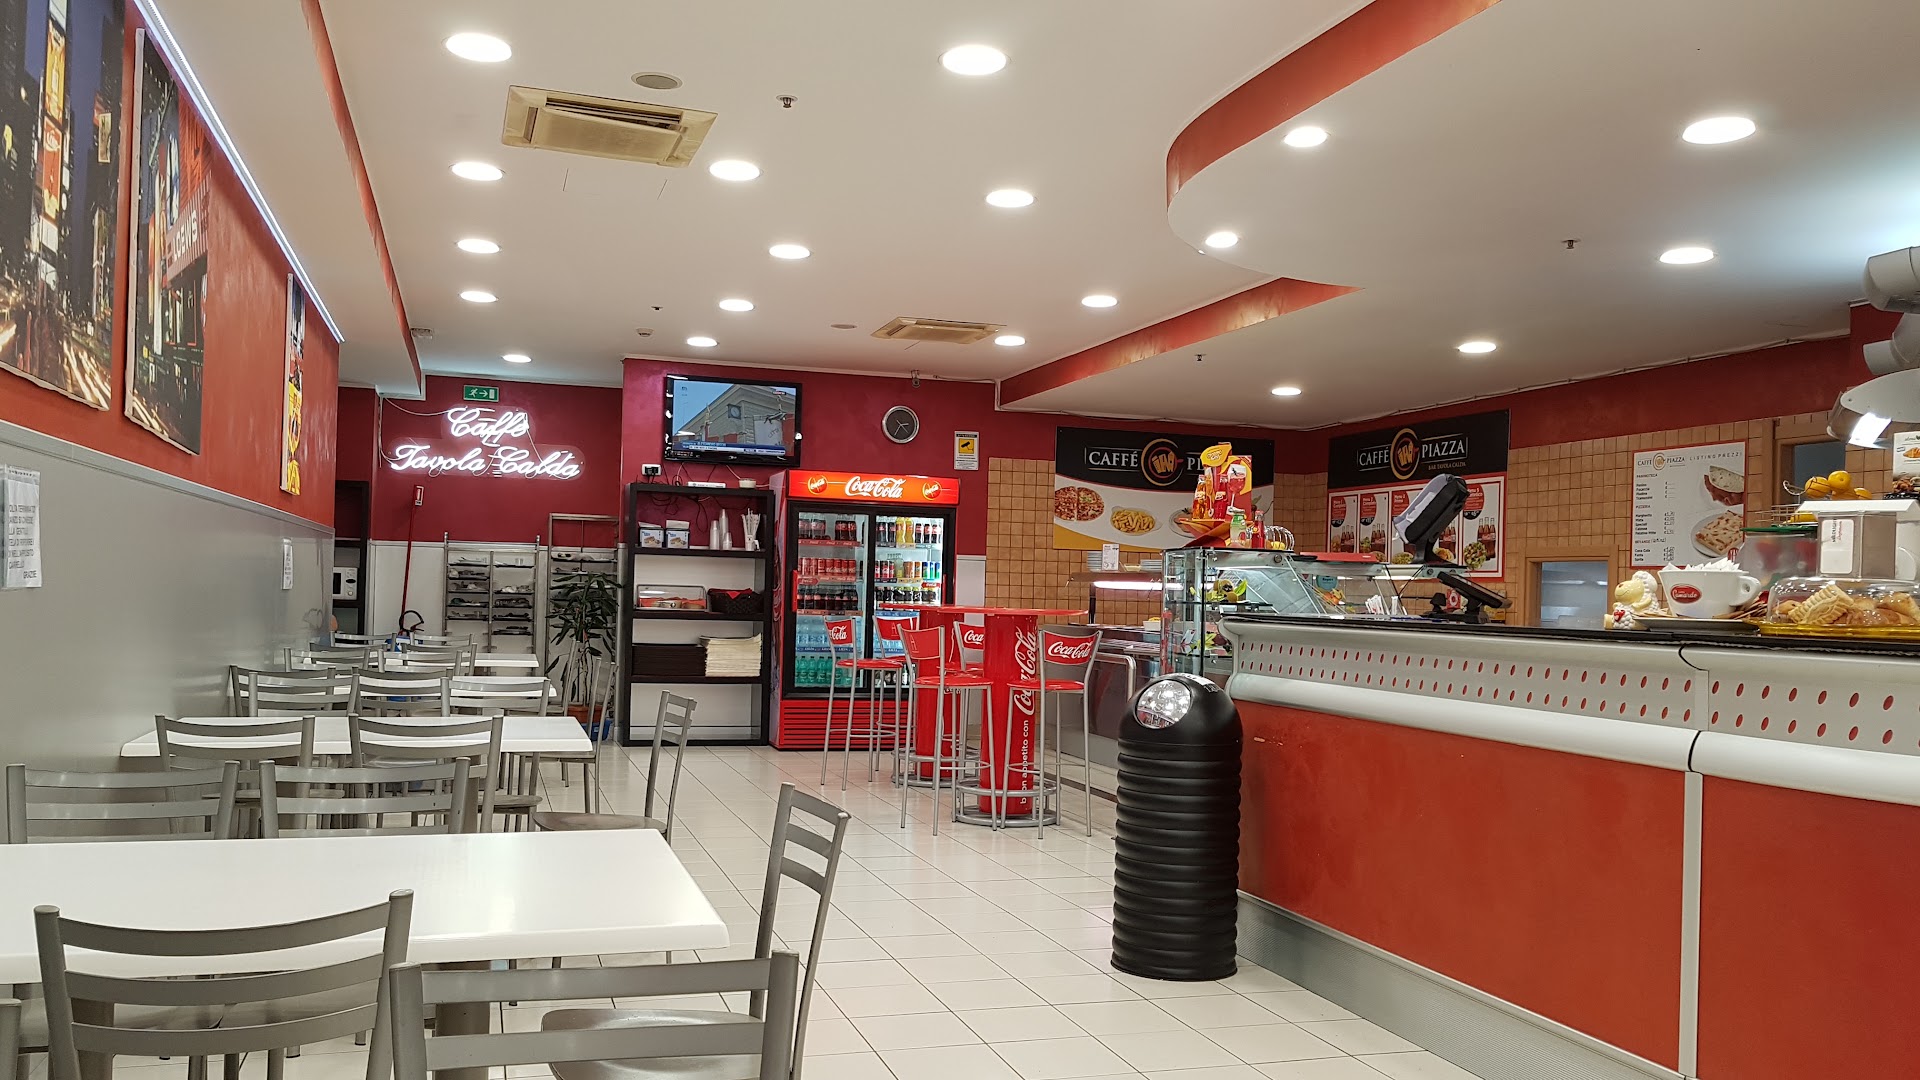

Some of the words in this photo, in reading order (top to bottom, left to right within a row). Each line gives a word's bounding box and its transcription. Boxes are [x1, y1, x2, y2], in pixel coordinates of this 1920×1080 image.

[391, 445, 486, 471] Tavola
[496, 444, 580, 477] Calda
[1088, 451, 1138, 468] CAFFÉ
[1187, 460, 1204, 471] PI
[1359, 446, 1390, 466] CAFFÉ
[1422, 440, 1466, 459] PIAZZA
[1717, 451, 1743, 459] PREZZI
[844, 476, 907, 498] Coca-Cola
[1047, 641, 1093, 659] Coca-Cola
